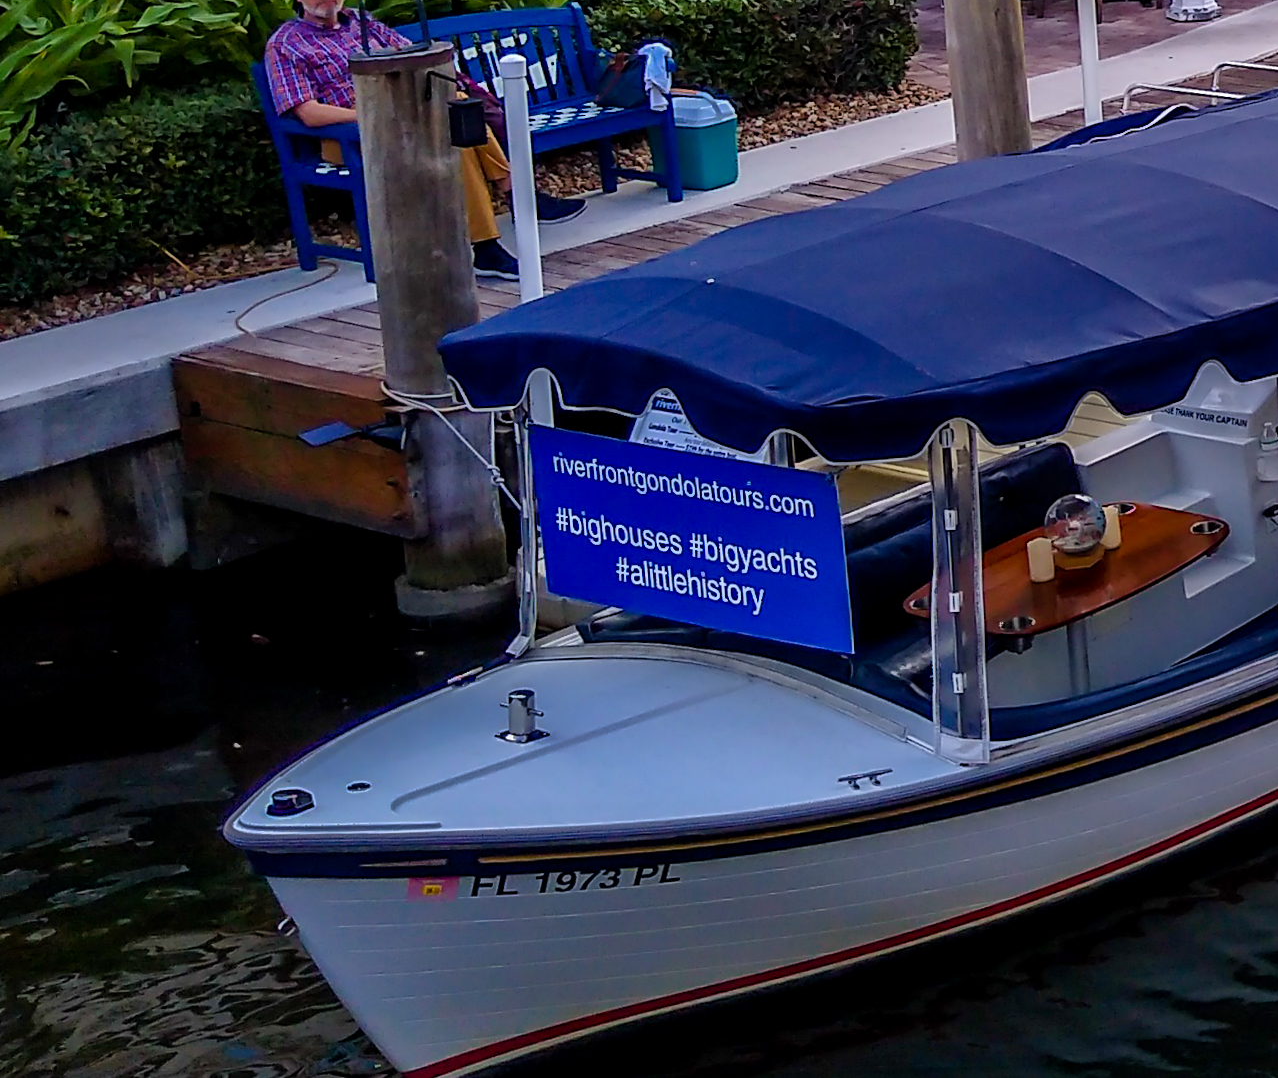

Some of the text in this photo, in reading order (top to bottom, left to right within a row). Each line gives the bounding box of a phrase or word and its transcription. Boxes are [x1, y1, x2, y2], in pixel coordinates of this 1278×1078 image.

[1176, 408, 1194, 418] THANK
[1196, 412, 1214, 422] YOUR
[1216, 415, 1247, 427] CAPTAIN
[553, 452, 815, 517] riverfrontgondolatours.com
[556, 506, 817, 579] #bighouses #bigyachts
[616, 556, 764, 615] #alittlehistory
[471, 875, 518, 897] FL
[536, 869, 621, 894] 1973
[634, 864, 681, 886] PL
